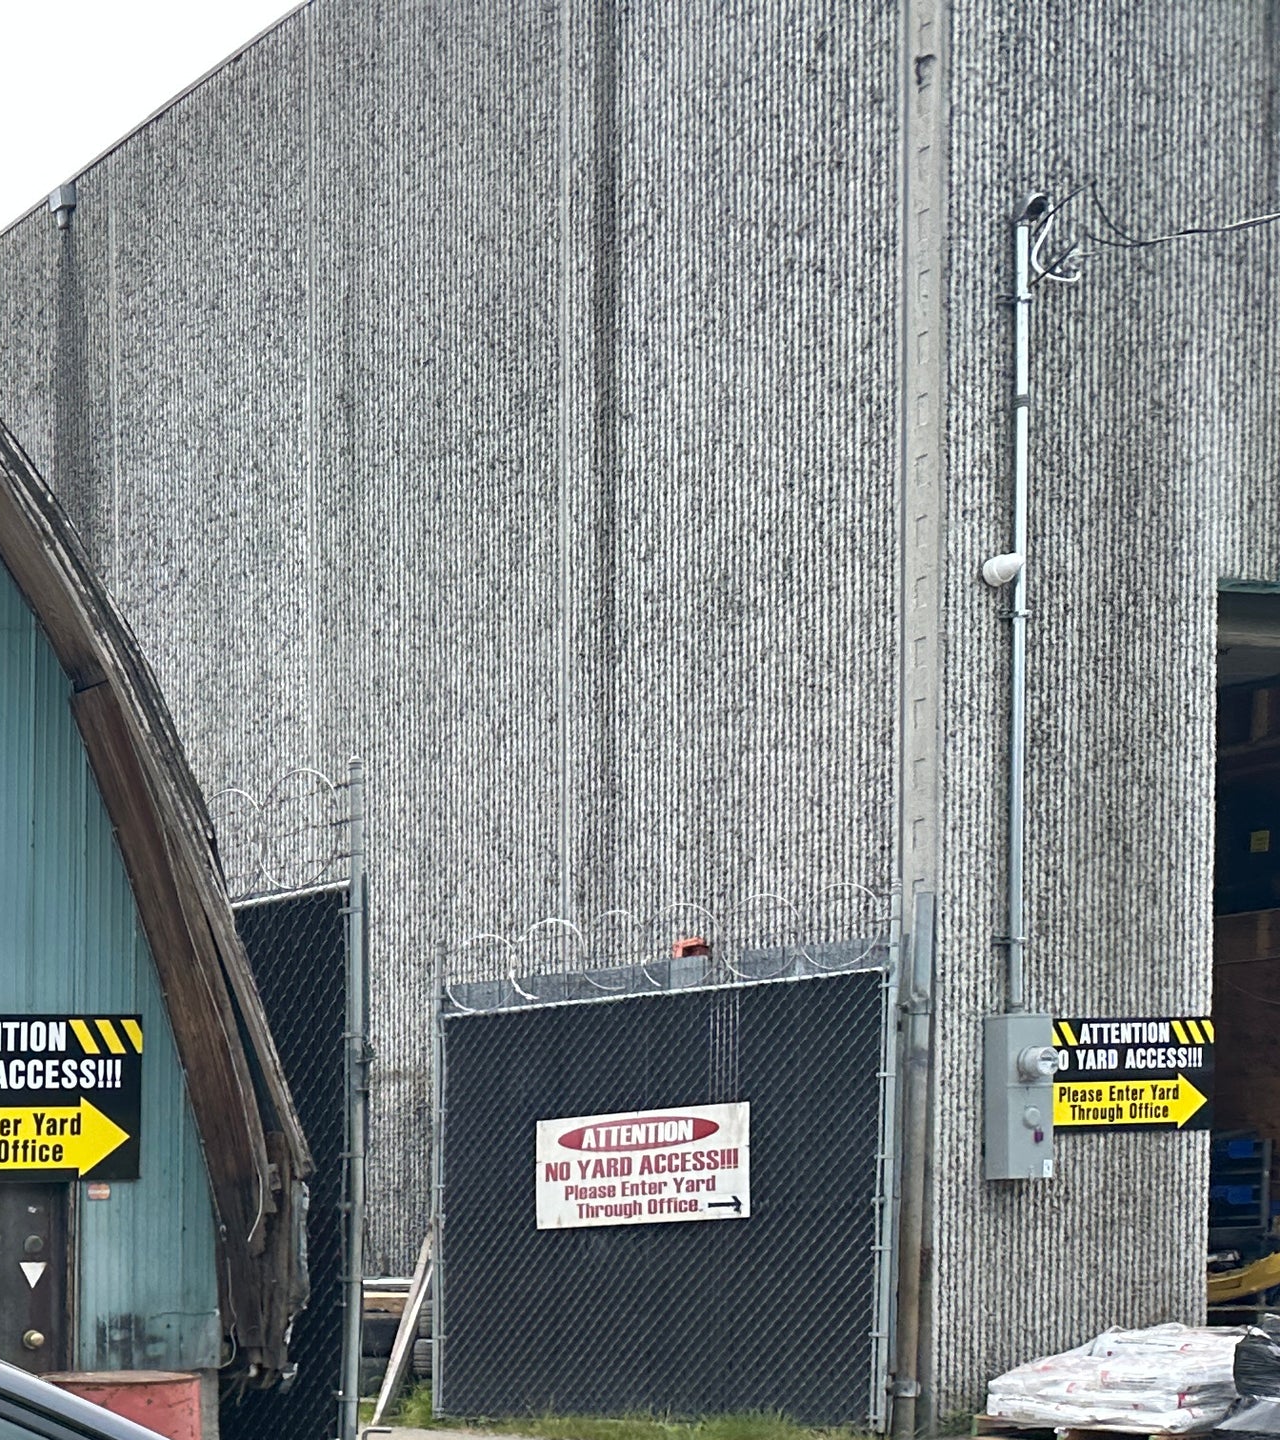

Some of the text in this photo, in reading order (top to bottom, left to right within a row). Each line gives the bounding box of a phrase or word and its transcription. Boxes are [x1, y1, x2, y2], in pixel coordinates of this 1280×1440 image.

[1079, 1021, 1170, 1044] ATTENTION
[1075, 1048, 1119, 1070] YARD
[1124, 1047, 1203, 1069] ACCESS!!!
[1058, 1083, 1180, 1103] Please Enter Yard
[1070, 1102, 1169, 1122] Through Office
[33, 1112, 82, 1136] Yard
[581, 1119, 694, 1150] ATTENTION
[545, 1148, 739, 1183] NO YARD ACCESS!!!
[564, 1175, 716, 1201] Please Enter Yard
[576, 1200, 643, 1219] Through
